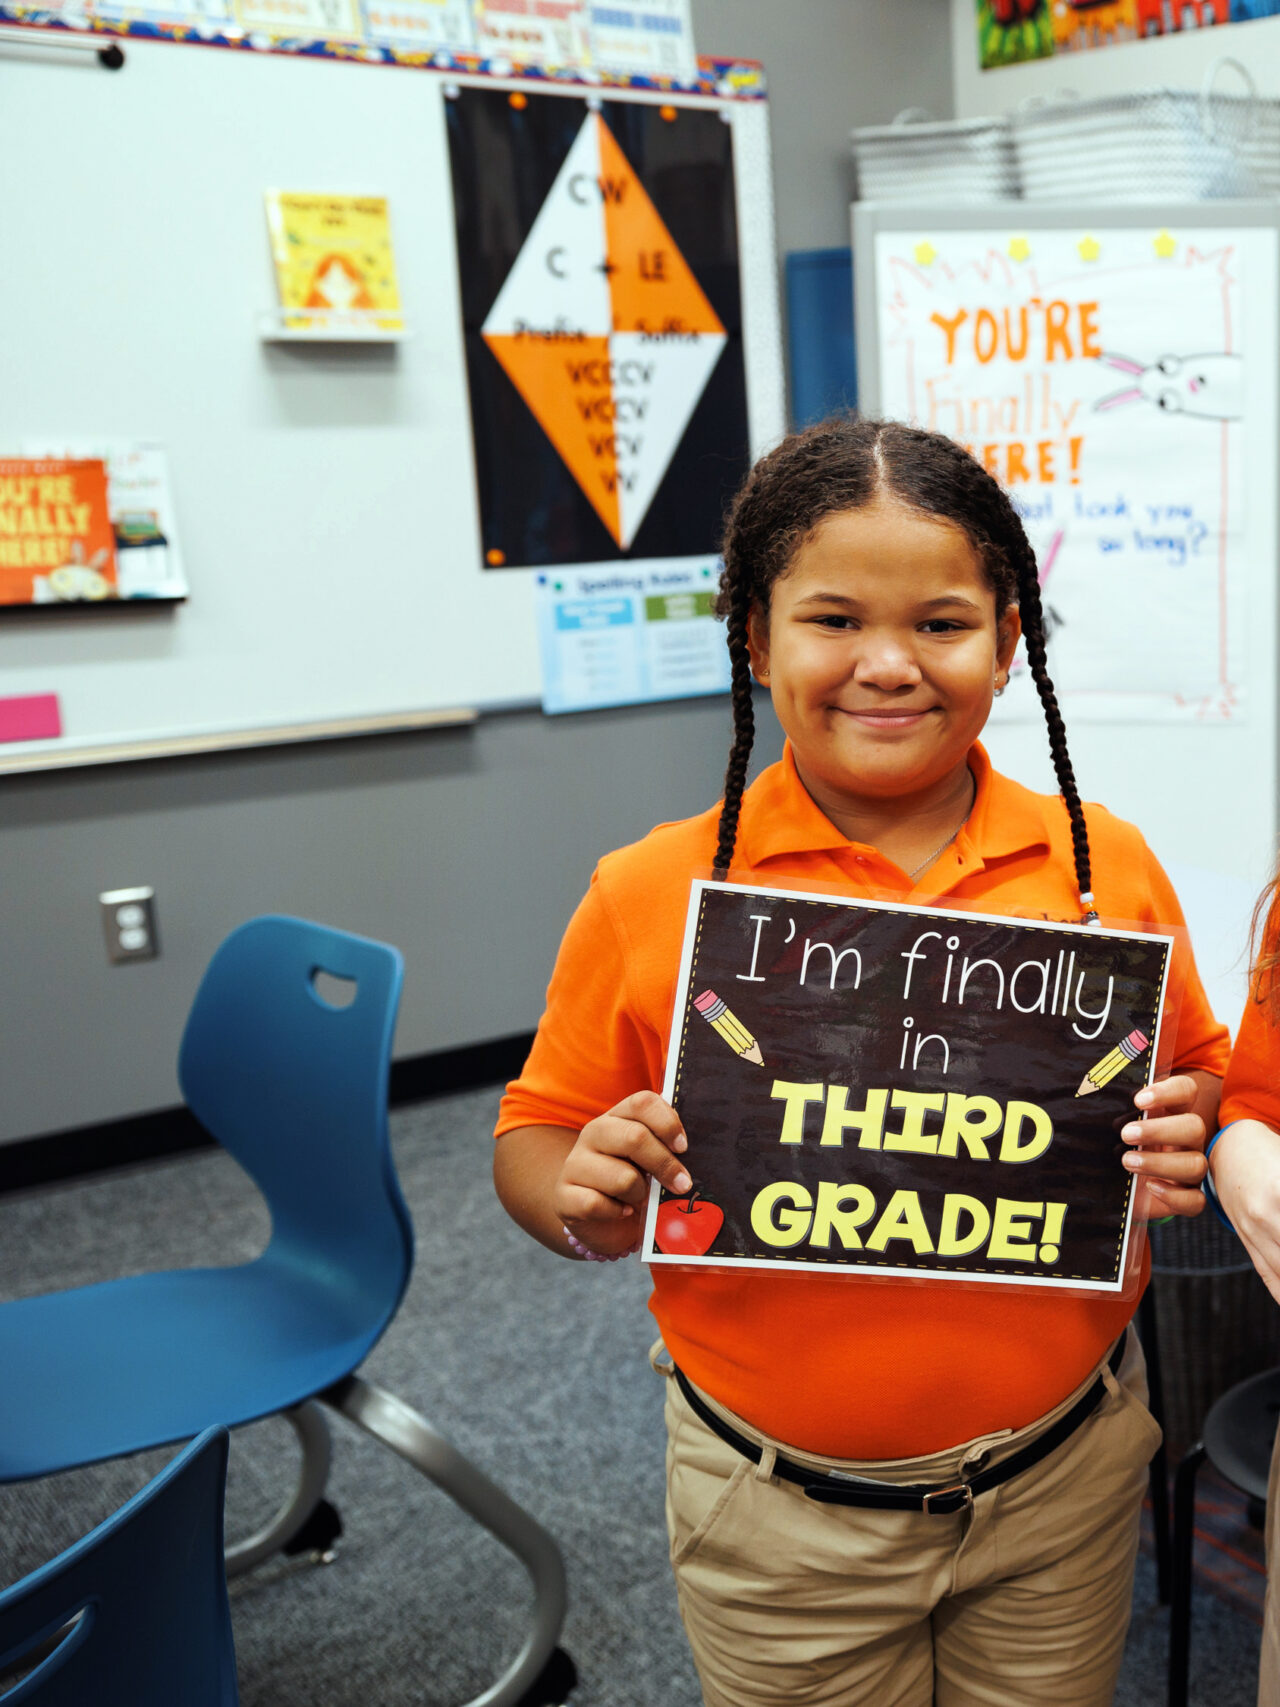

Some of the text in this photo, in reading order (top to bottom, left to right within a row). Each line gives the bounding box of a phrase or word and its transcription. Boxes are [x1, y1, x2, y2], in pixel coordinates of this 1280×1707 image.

[545, 247, 566, 279] C
[638, 250, 669, 281] LE
[929, 297, 1104, 365] YOU'RE
[564, 360, 656, 386] VCCCV
[575, 396, 650, 423] VCCV
[586, 431, 644, 458] VCV
[964, 434, 1084, 486] ERE!
[600, 470, 639, 495] VV
[1145, 504, 1193, 525] you
[1133, 521, 1209, 567] long?
[736, 913, 1115, 1041] I'm finally
[899, 1016, 951, 1075] in
[769, 1079, 1055, 1165] THIRD
[749, 1181, 1069, 1265] GRADE!
